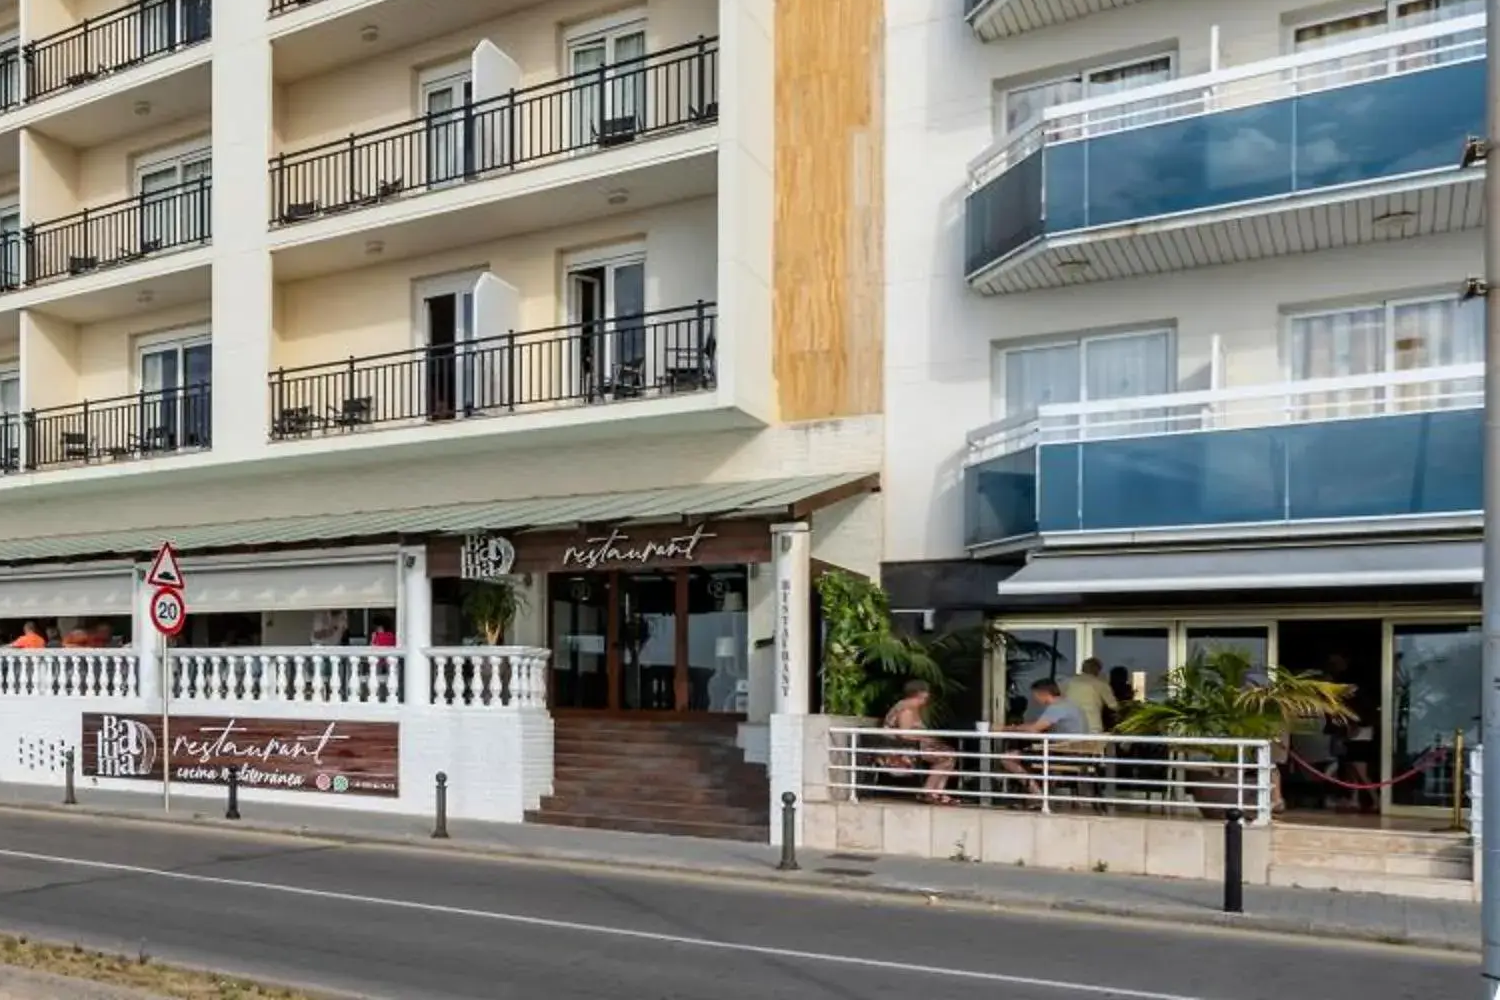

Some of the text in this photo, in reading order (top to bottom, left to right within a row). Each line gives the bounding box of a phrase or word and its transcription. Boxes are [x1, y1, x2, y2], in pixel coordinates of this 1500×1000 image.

[563, 524, 717, 568] restaurant
[158, 602, 177, 620] 20
[173, 719, 350, 764] restaurant
[177, 762, 305, 787] cocina mditerránea
